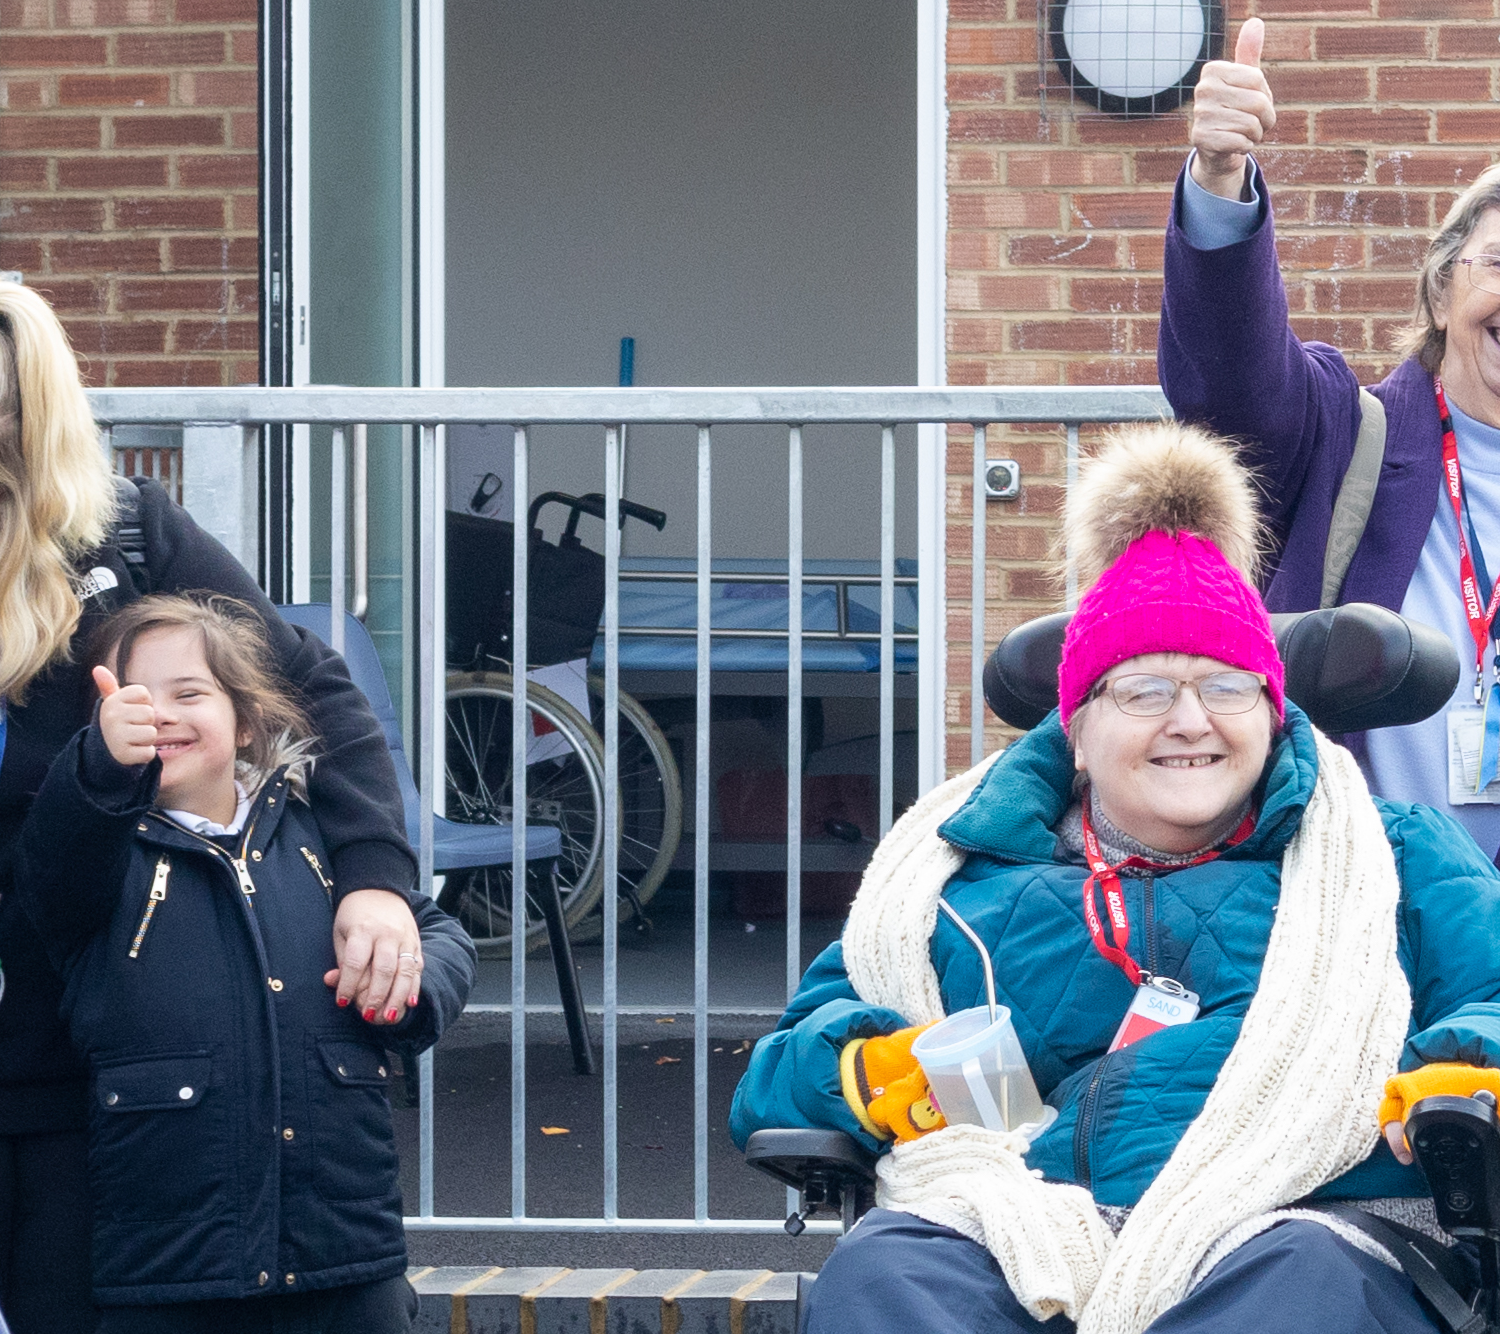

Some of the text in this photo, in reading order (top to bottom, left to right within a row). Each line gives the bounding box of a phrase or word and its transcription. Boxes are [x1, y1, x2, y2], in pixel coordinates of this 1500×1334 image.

[1445, 458, 1460, 498] VISITOR
[1461, 576, 1480, 620] VISITOR
[1108, 891, 1126, 929] VISITOR
[1147, 996, 1181, 1017] SAND
